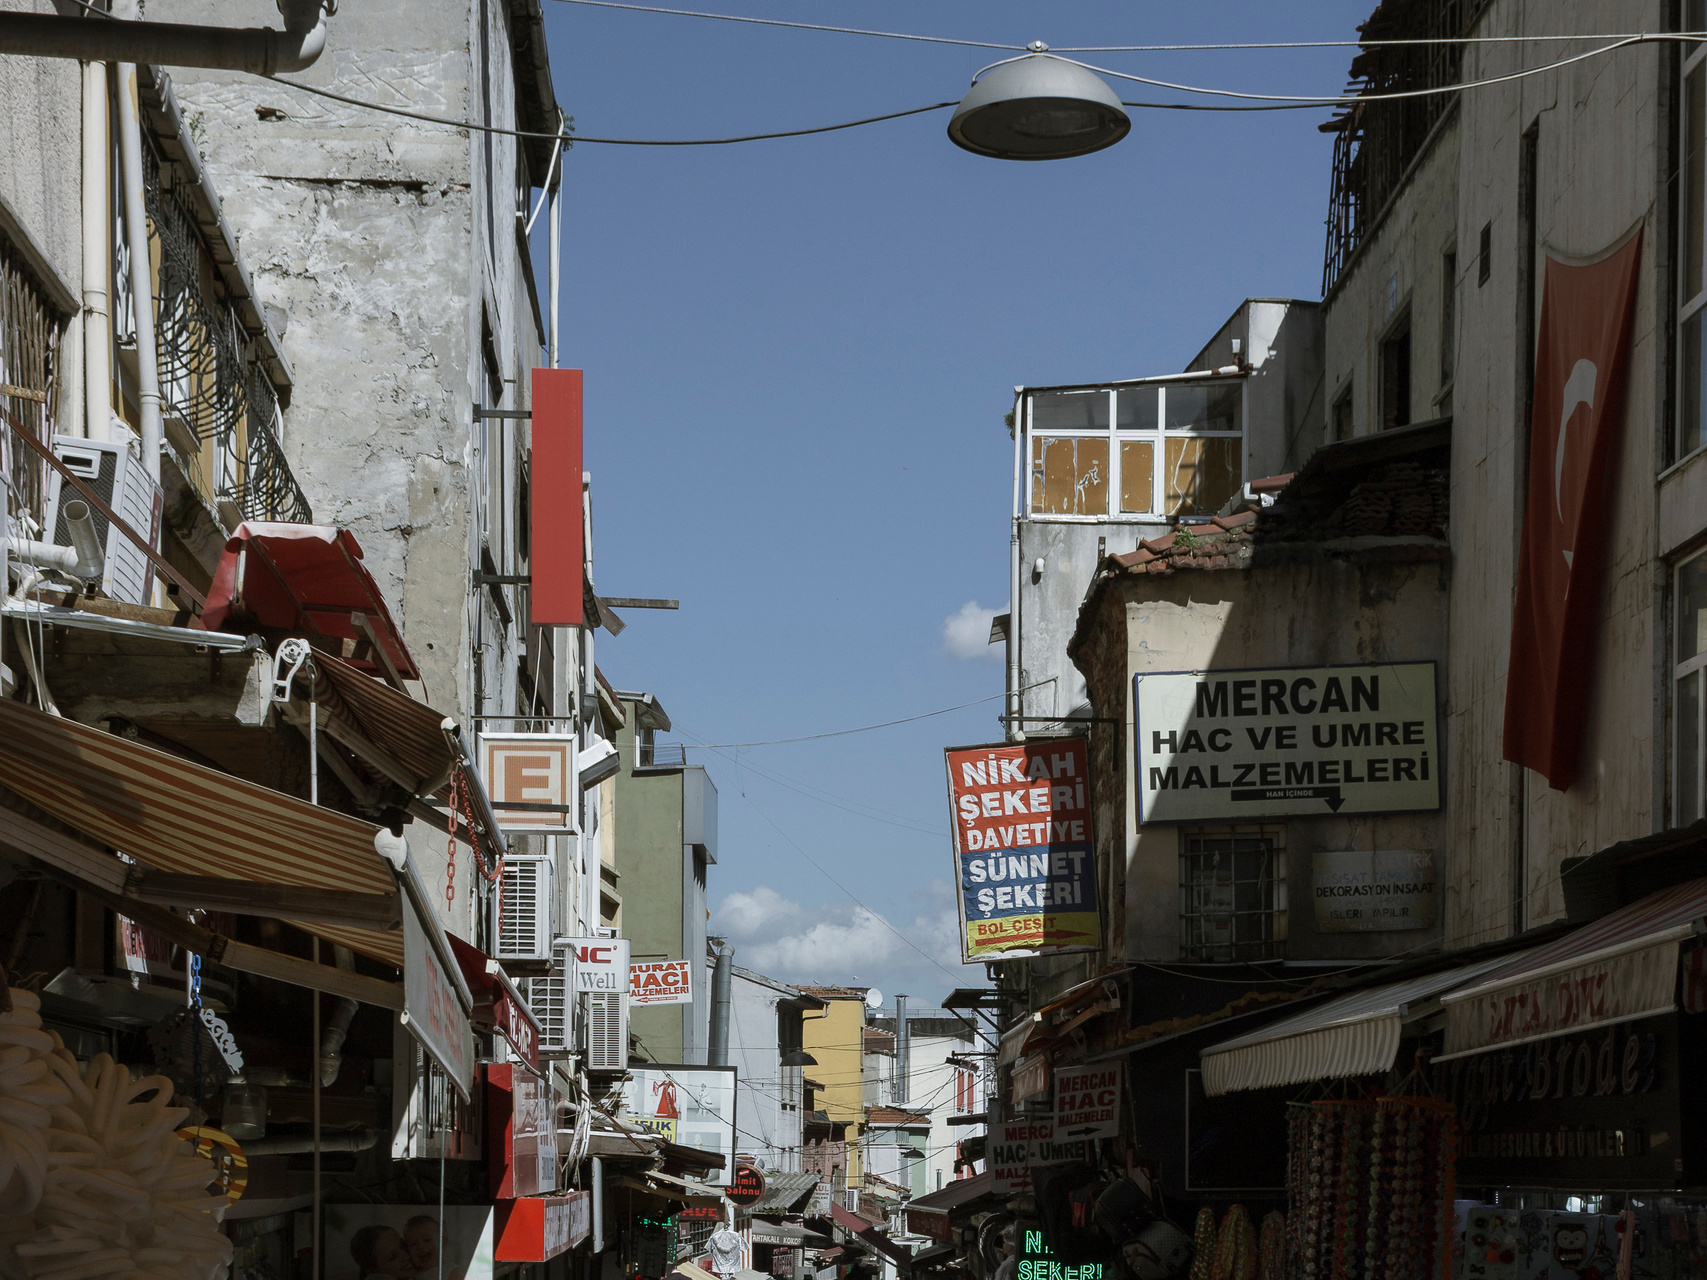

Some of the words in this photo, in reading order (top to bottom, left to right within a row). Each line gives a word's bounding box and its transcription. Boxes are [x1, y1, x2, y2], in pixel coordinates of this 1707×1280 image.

[1195, 675, 1380, 718] MERCAN
[1152, 728, 1233, 754] HAC
[1245, 725, 1298, 751] VE
[1312, 721, 1425, 749] UMRE
[961, 752, 1075, 787] NİKAH
[1149, 751, 1430, 790] MALZEMELERİ
[959, 777, 1085, 828] ŞEKERİ
[1266, 790, 1284, 798] HAN
[1285, 789, 1314, 799] İÇİNDE
[966, 817, 1086, 851] DAVETİYE
[968, 851, 1086, 883] SÜNNET
[977, 875, 1082, 919] ŞEKERİ
[1315, 884, 1391, 898] DEKORASYON
[978, 919, 1008, 936] BOL
[580, 972, 616, 989] Well
[630, 986, 689, 997] ALZEMELERİ
[1058, 1071, 1117, 1094] MERCAN
[1058, 1090, 1116, 1113] HAC
[1058, 1106, 1114, 1128] MALZEMELERİ
[993, 1144, 1026, 1164] HAC
[726, 1186, 760, 1196] Salonu
